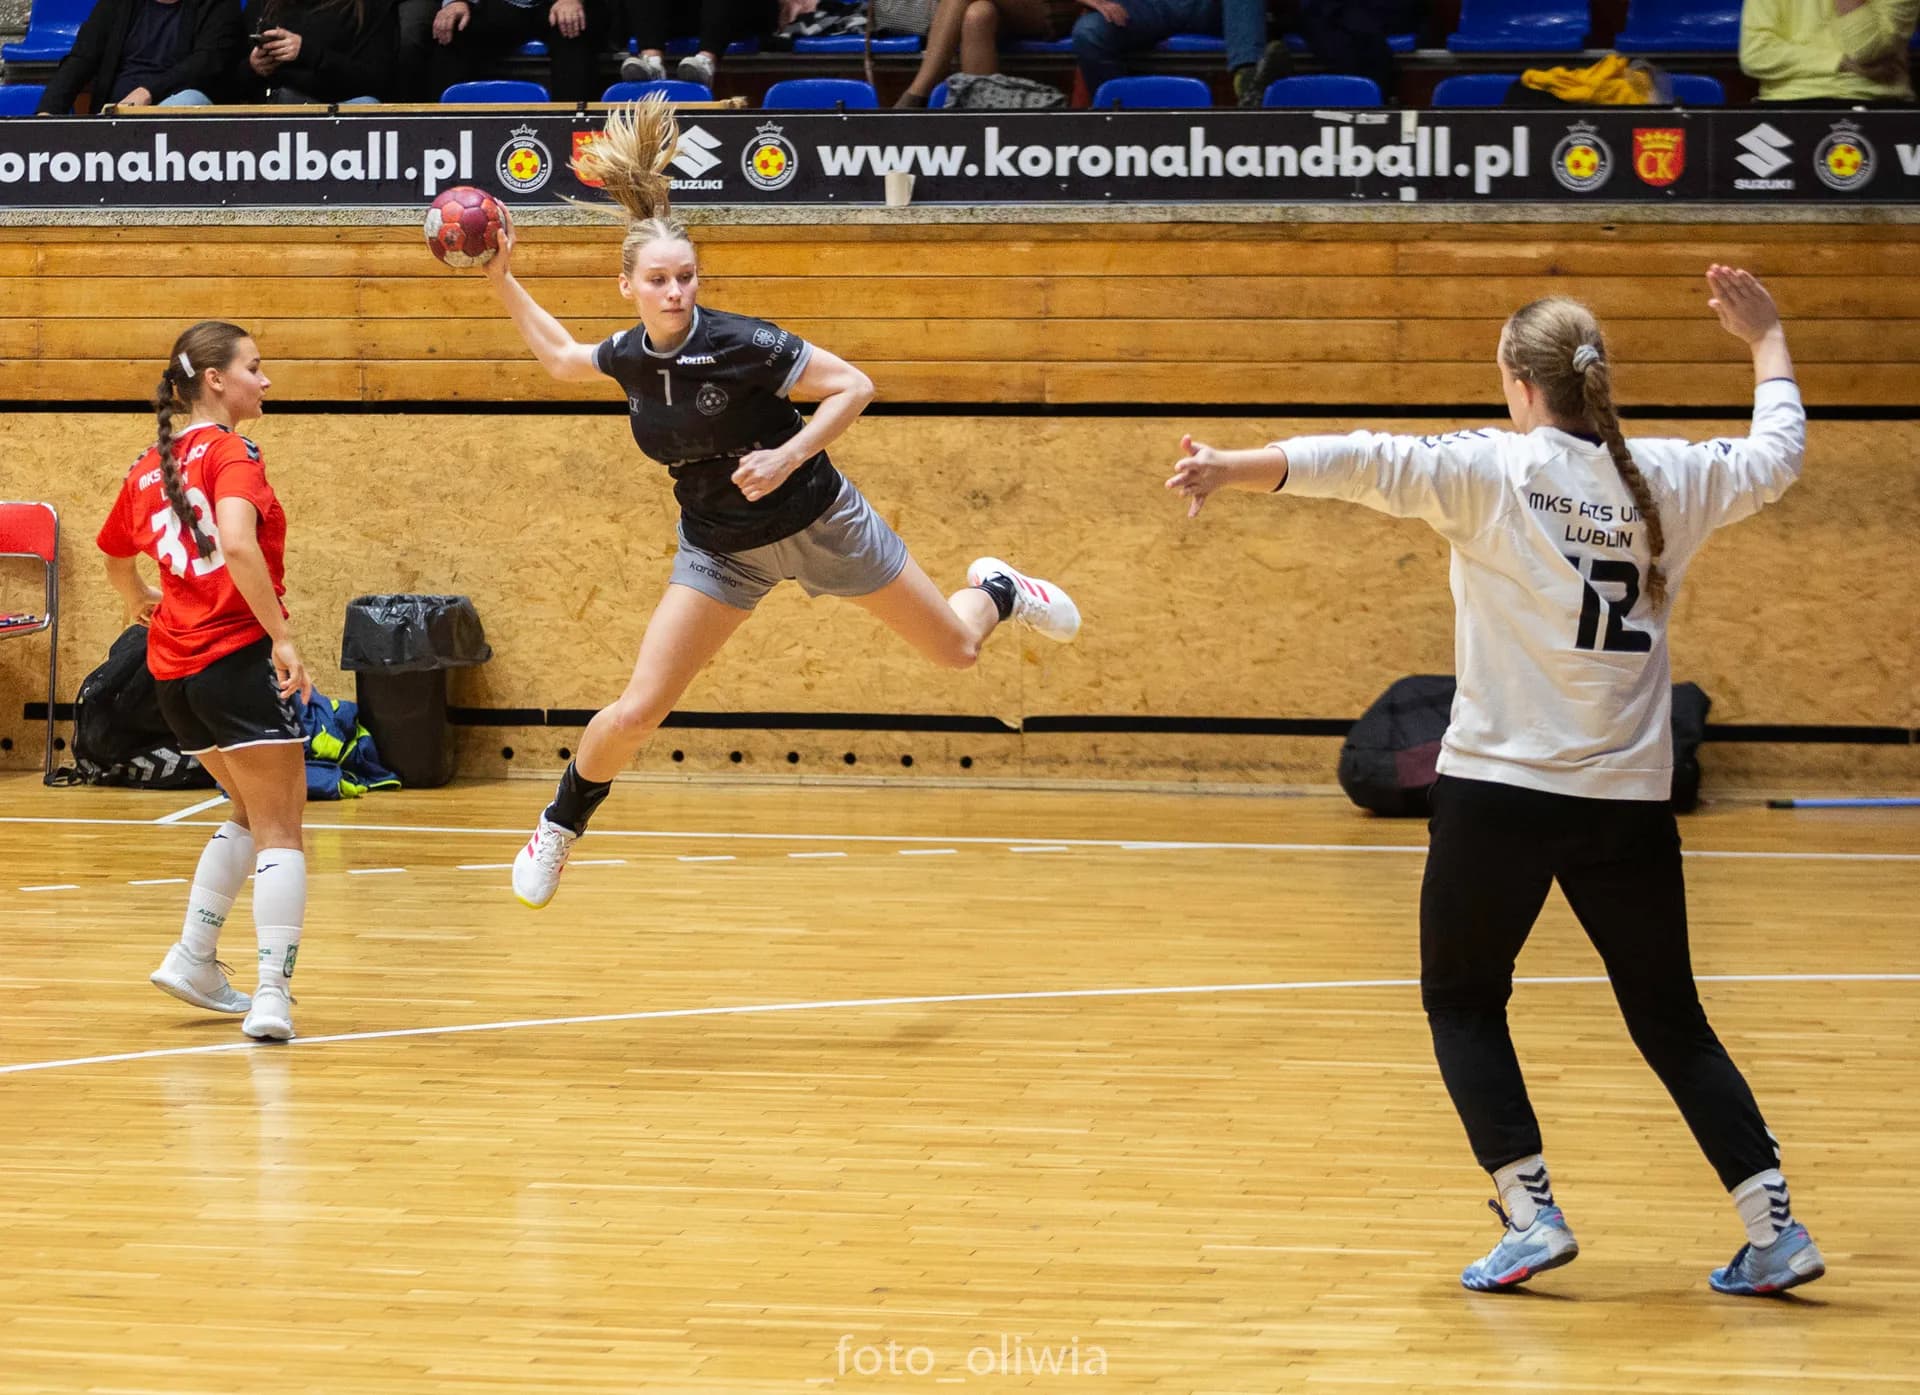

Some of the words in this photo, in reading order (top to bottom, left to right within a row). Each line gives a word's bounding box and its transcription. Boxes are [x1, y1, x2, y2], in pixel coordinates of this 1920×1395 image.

[816, 126, 1529, 194] www.koronahandball.pl
[670, 179, 723, 190] SUZUKI
[1734, 179, 1794, 190] SUZUKI
[139, 468, 161, 491] MKS
[1528, 492, 1573, 514] MKS
[1579, 501, 1613, 522] AZS
[1565, 524, 1633, 548] LUBLIN
[1564, 556, 1652, 652] 12
